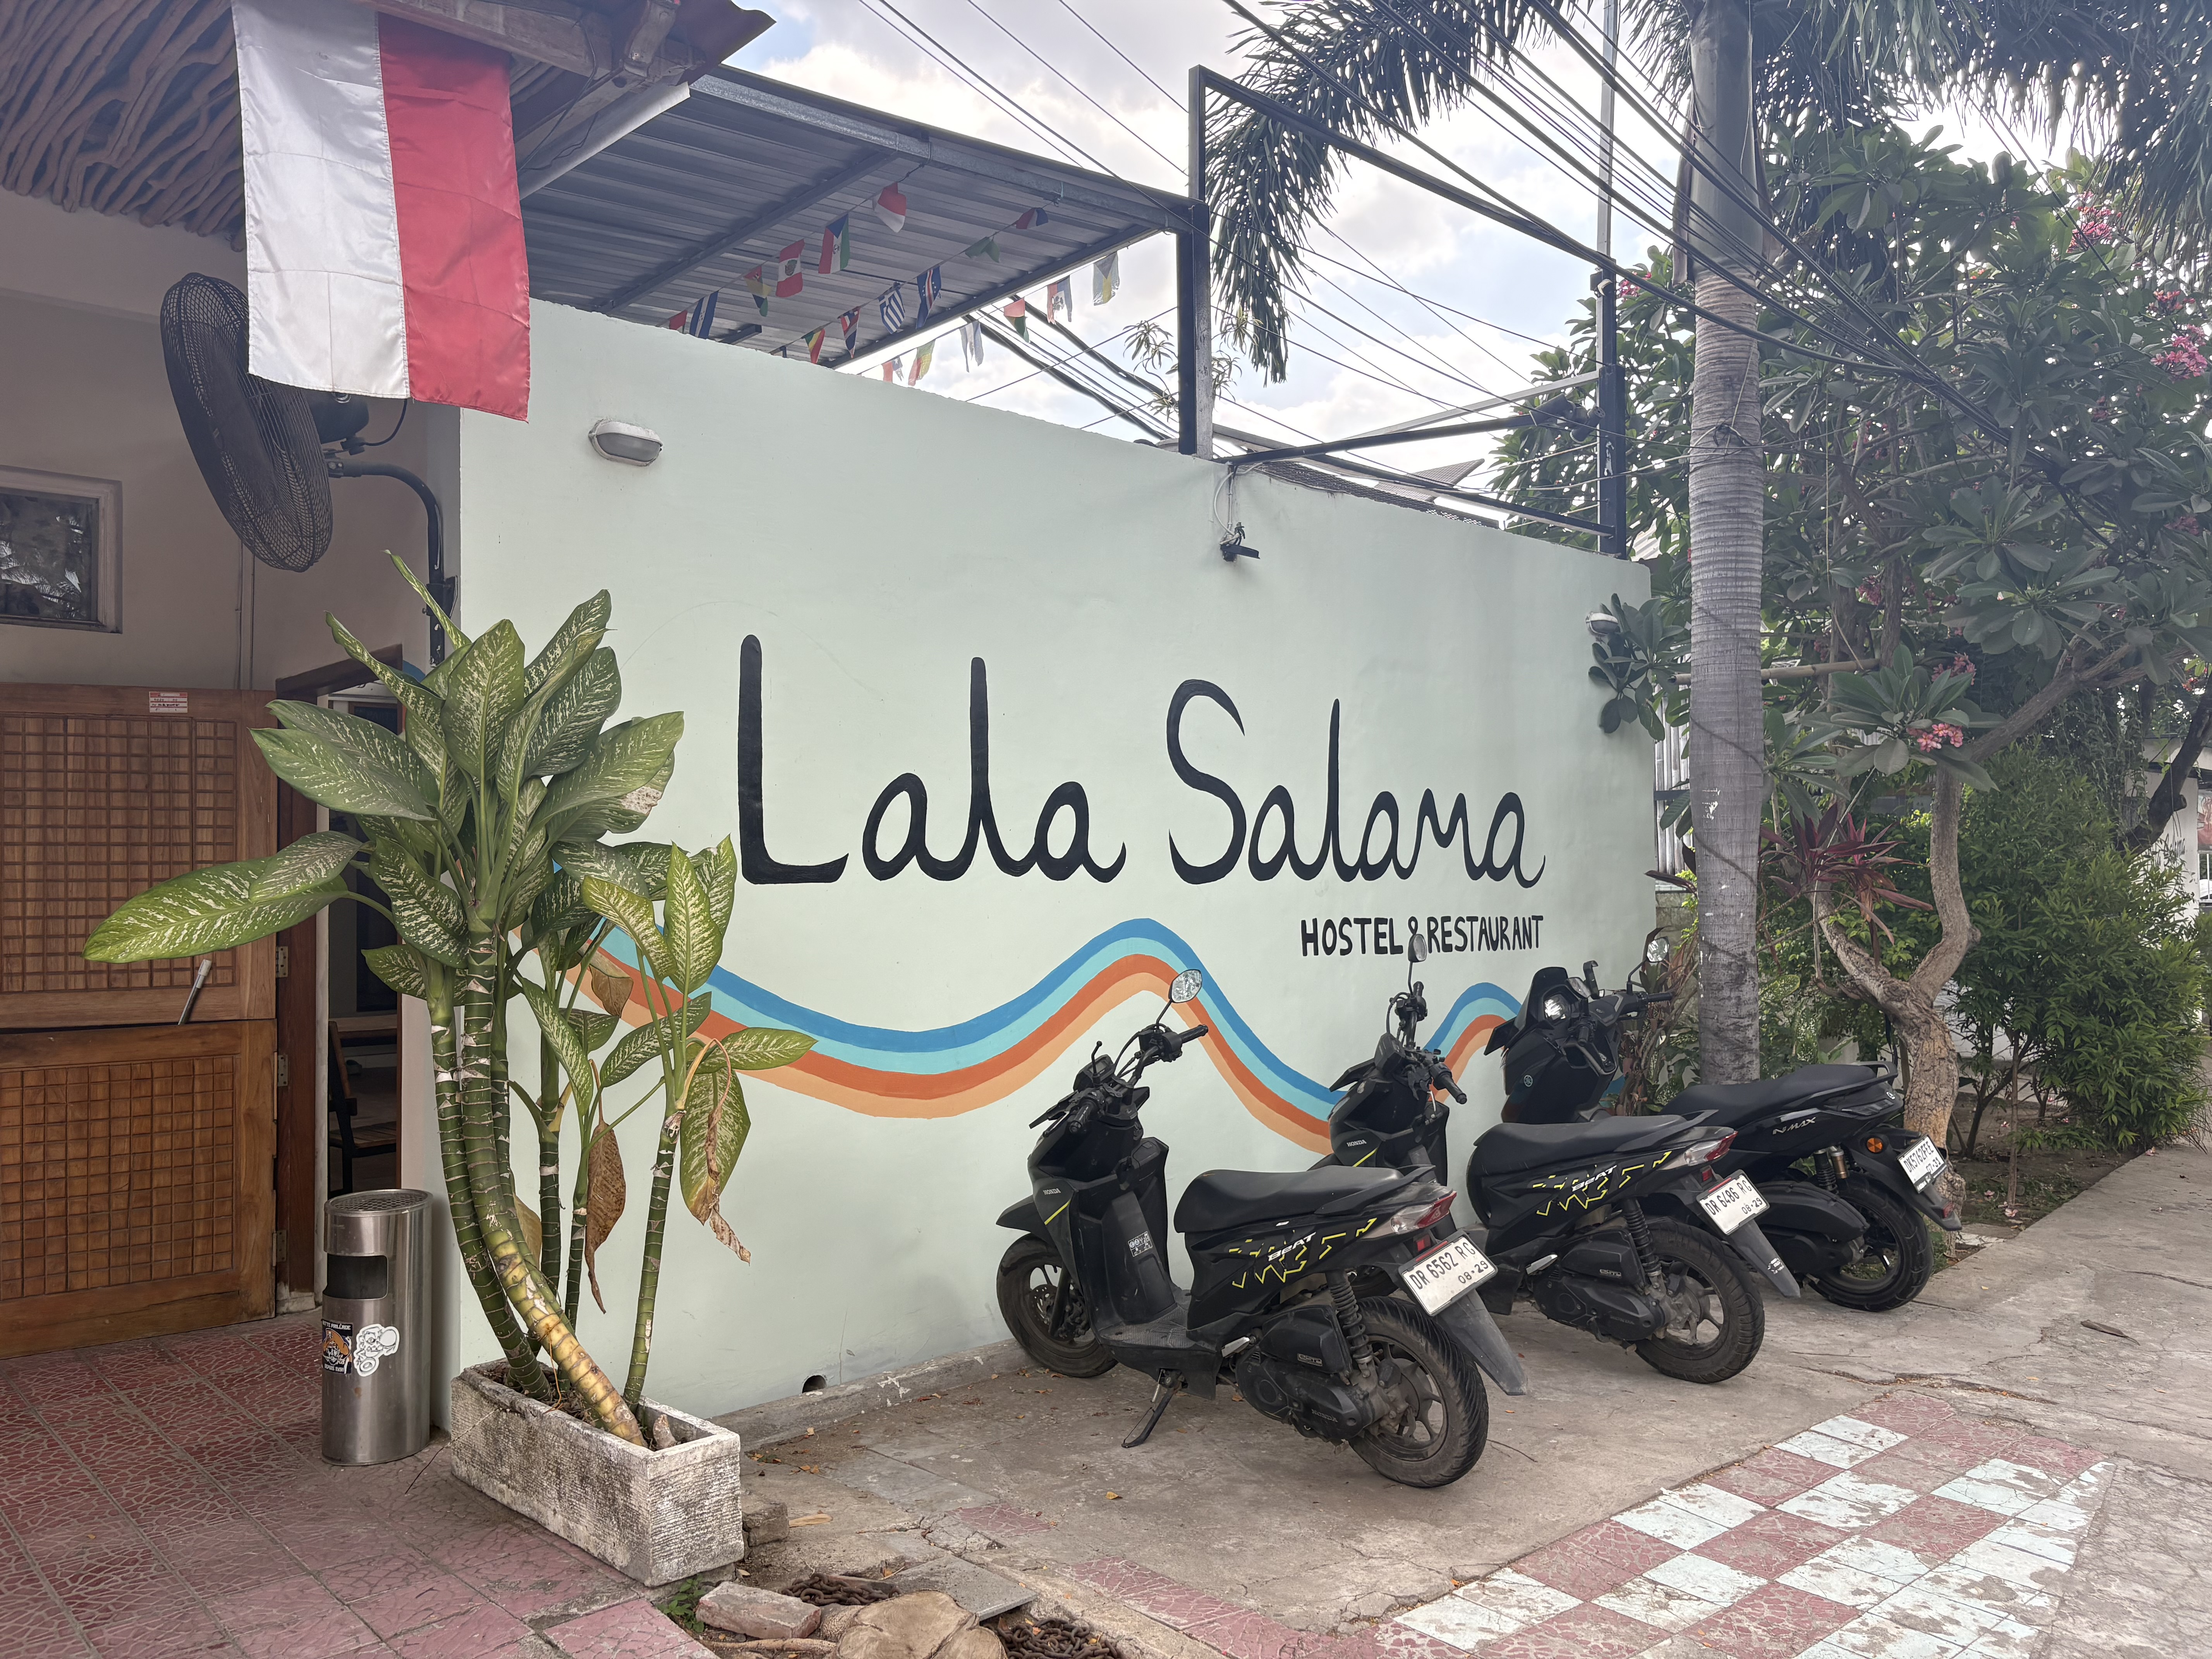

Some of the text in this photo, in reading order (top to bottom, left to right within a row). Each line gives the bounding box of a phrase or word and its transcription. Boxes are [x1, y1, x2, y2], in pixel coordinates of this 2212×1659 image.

[738, 634, 1546, 888] Lala Salama
[1301, 917, 1403, 957] HOSTEL
[1427, 915, 1544, 954] RESTAURANT
[1772, 1117, 1816, 1135] NMAX
[1705, 1200, 1721, 1215] DR
[1717, 1187, 1740, 1207] 6486
[1409, 1270, 1431, 1290] DR
[1426, 1252, 1459, 1278] 6562
